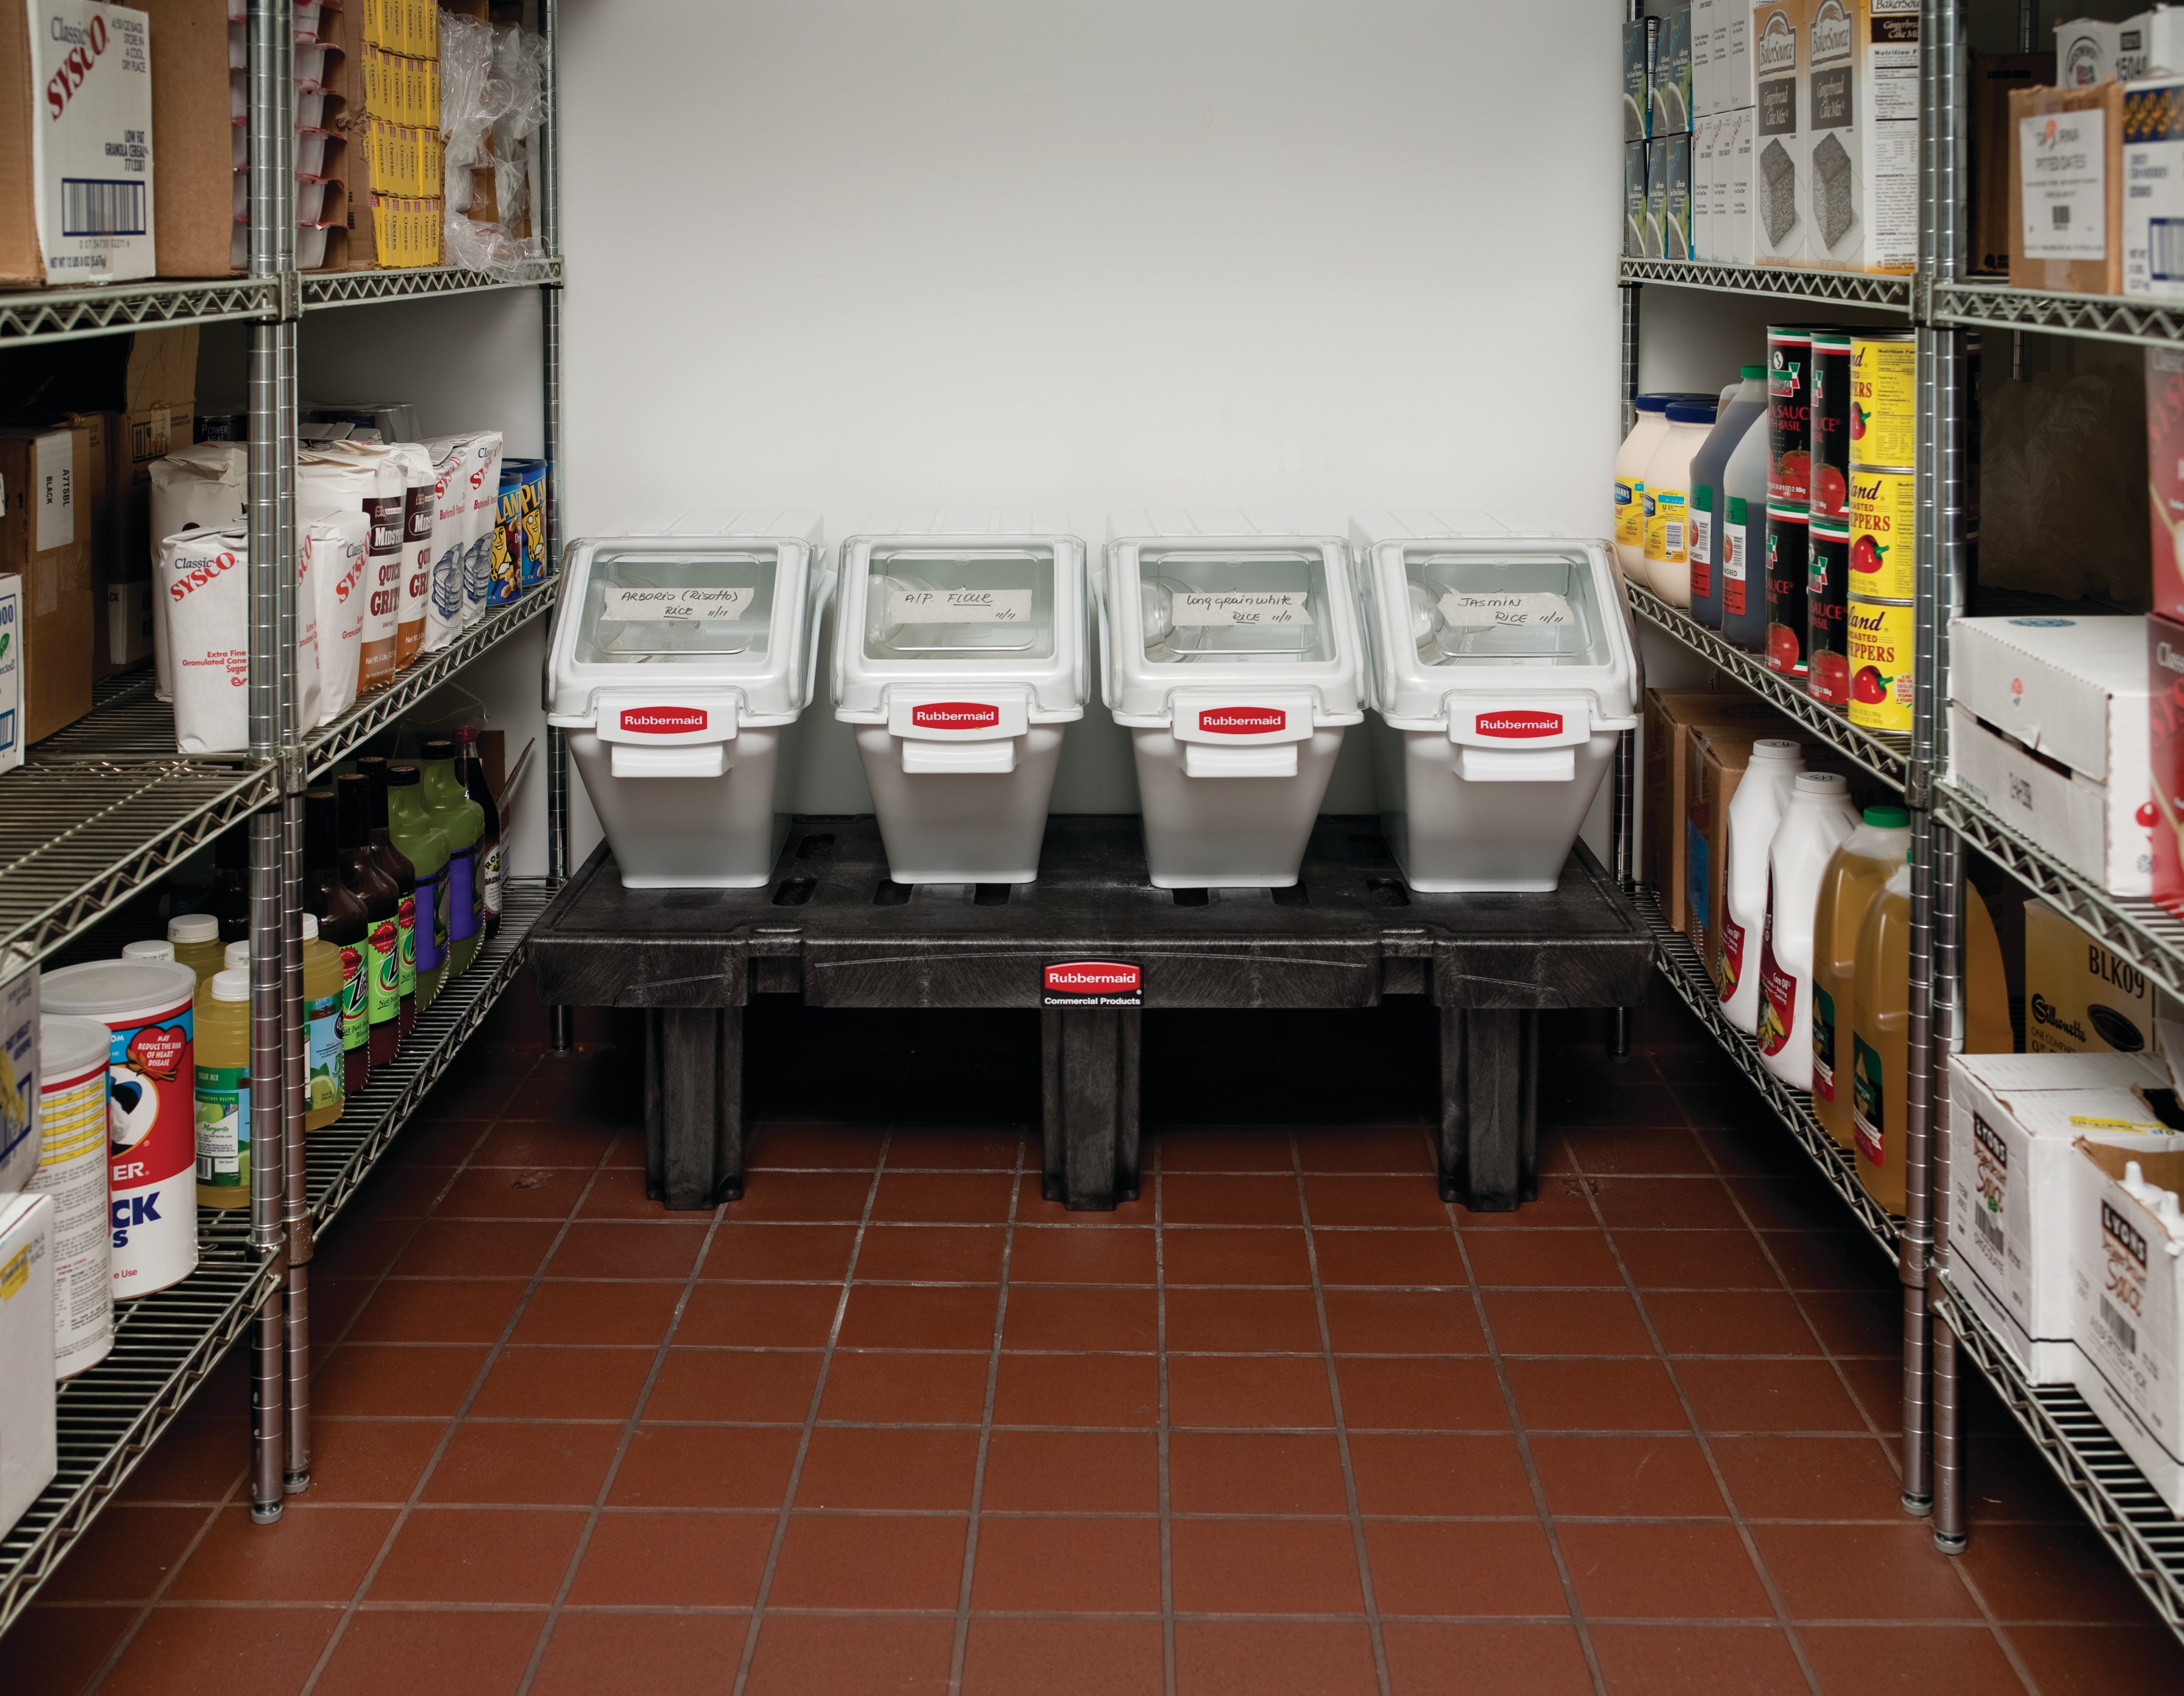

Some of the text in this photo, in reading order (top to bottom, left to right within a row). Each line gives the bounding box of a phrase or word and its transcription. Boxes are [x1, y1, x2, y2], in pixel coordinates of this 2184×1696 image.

[1876, 0, 1919, 9] BakerSou
[51, 16, 85, 45] Classic
[1883, 20, 1919, 31] Gingerbrea
[1813, 26, 1849, 55] BakerSource
[1888, 30, 1905, 38] Cake
[1760, 38, 1793, 66] BakerSource
[46, 15, 107, 121] SYSCO
[1817, 74, 1844, 102] Gingerbread
[1763, 85, 1788, 111] Gingerbread
[1819, 99, 1842, 118] Cake Mix
[1766, 109, 1786, 126] Cake Mix
[201, 424, 228, 434] POWER
[1779, 420, 1802, 432] BASIL
[175, 557, 212, 569] Classic
[336, 531, 371, 604] SYSCO
[170, 552, 235, 602] SYSCO
[681, 590, 738, 602] (Risotto)
[1256, 594, 1292, 605] white
[1849, 606, 1885, 632] land
[182, 658, 224, 666] Granulated
[226, 665, 247, 674] Sugar
[625, 714, 703, 726] Rubbermaid
[916, 710, 995, 722] Rubbermaid
[1203, 715, 1281, 727] Rubbermaid
[1480, 718, 1559, 730] Rubbermaid
[485, 852, 500, 870] ROS
[1049, 972, 1136, 983] Rubbermaid
[2088, 944, 2144, 999] BLK09
[1773, 972, 1781, 986] Corn
[1774, 990, 1787, 1005] Cooking
[1776, 986, 1787, 999] Baking
[379, 999, 389, 1007] Not
[2032, 993, 2086, 1042] Silhouette
[2031, 1027, 2044, 1041] ONE
[202, 1124, 229, 1135] Margarita
[1975, 1119, 2005, 1162] LYONS
[2104, 1206, 2145, 1262] LYONS
[121, 1269, 138, 1278] Use
